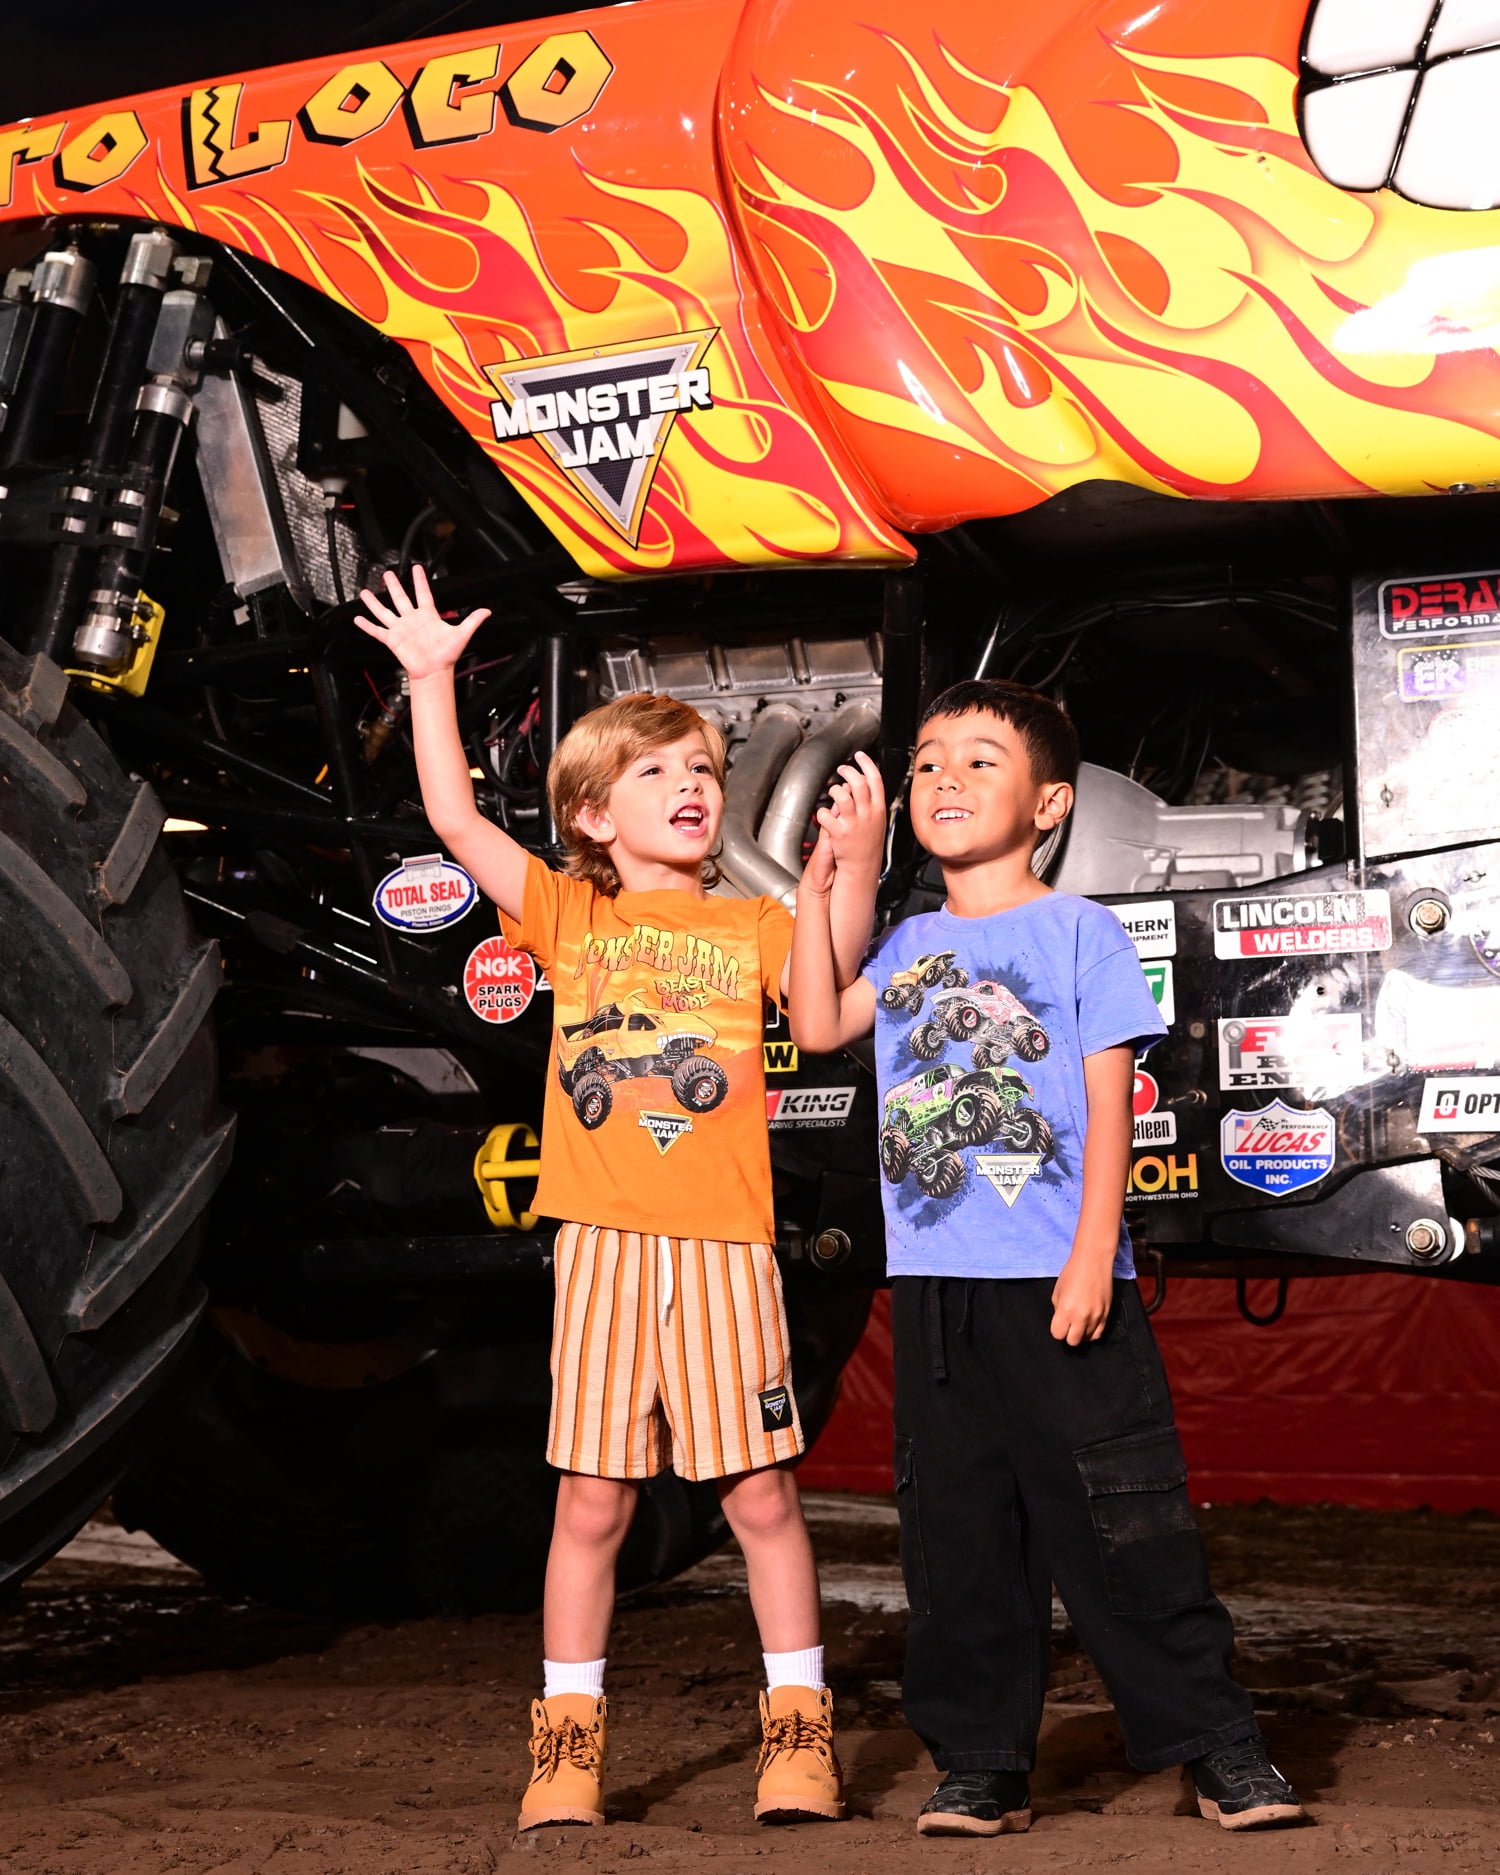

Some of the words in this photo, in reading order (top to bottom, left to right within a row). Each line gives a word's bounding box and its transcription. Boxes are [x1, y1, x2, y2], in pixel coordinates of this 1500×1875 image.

[182, 30, 614, 191] LOCO
[489, 367, 713, 442] MONSTER
[560, 418, 655, 468] JAM
[1391, 577, 1500, 619] DERA
[385, 884, 428, 908] TOTAL
[430, 880, 465, 904] SEAL
[401, 906, 428, 917] PISTON
[429, 904, 452, 914] RINGS
[1223, 898, 1357, 929] LINCOLN
[1130, 933, 1169, 942] IPMENT
[1254, 926, 1374, 953] WELDERS
[475, 955, 522, 979] NGK
[678, 934, 740, 1001] JAM
[478, 984, 521, 996] SPARK
[654, 974, 712, 996] BEAST
[478, 997, 522, 1009] PLUGS
[661, 992, 713, 1013] MODE
[781, 1093, 850, 1115] KING
[1464, 1093, 1500, 1114] OPT
[638, 1118, 693, 1133] MONSTER
[652, 1128, 678, 1139] JAM
[767, 1120, 794, 1130] ARING
[795, 1118, 848, 1129] SPECIALISTS
[1235, 1131, 1326, 1153] LUCAS
[976, 1165, 1041, 1176] MONSTER
[1229, 1159, 1252, 1170] OIL
[1255, 1159, 1329, 1170] PRODUCTS
[995, 1174, 1023, 1186] JAM
[1265, 1174, 1293, 1185] INC.
[1181, 1191, 1199, 1199] OHIO
